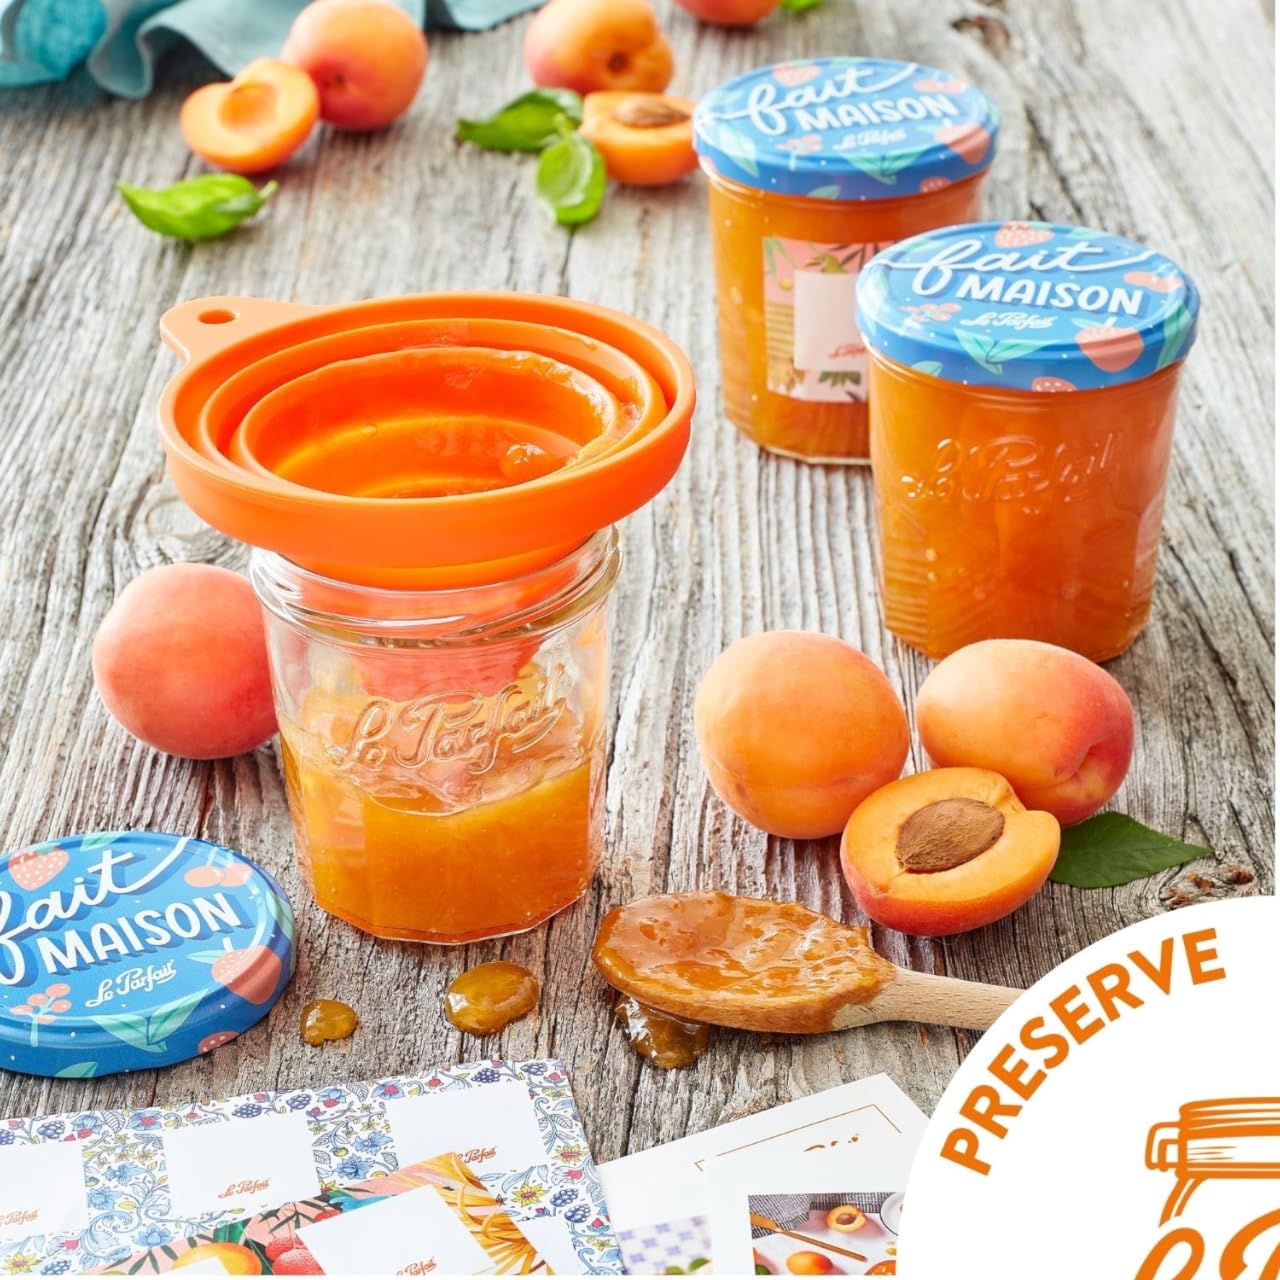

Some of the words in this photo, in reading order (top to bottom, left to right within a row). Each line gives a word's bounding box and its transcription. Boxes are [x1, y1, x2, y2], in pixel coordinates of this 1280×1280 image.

[740, 62, 916, 136] fait
[796, 94, 960, 132] MAISON
[900, 238, 1142, 296] fait
[955, 273, 1144, 316] MAISON
[36, 892, 242, 975] MAISON
[85, 978, 116, 1008] Le
[115, 959, 177, 996] Parfait
